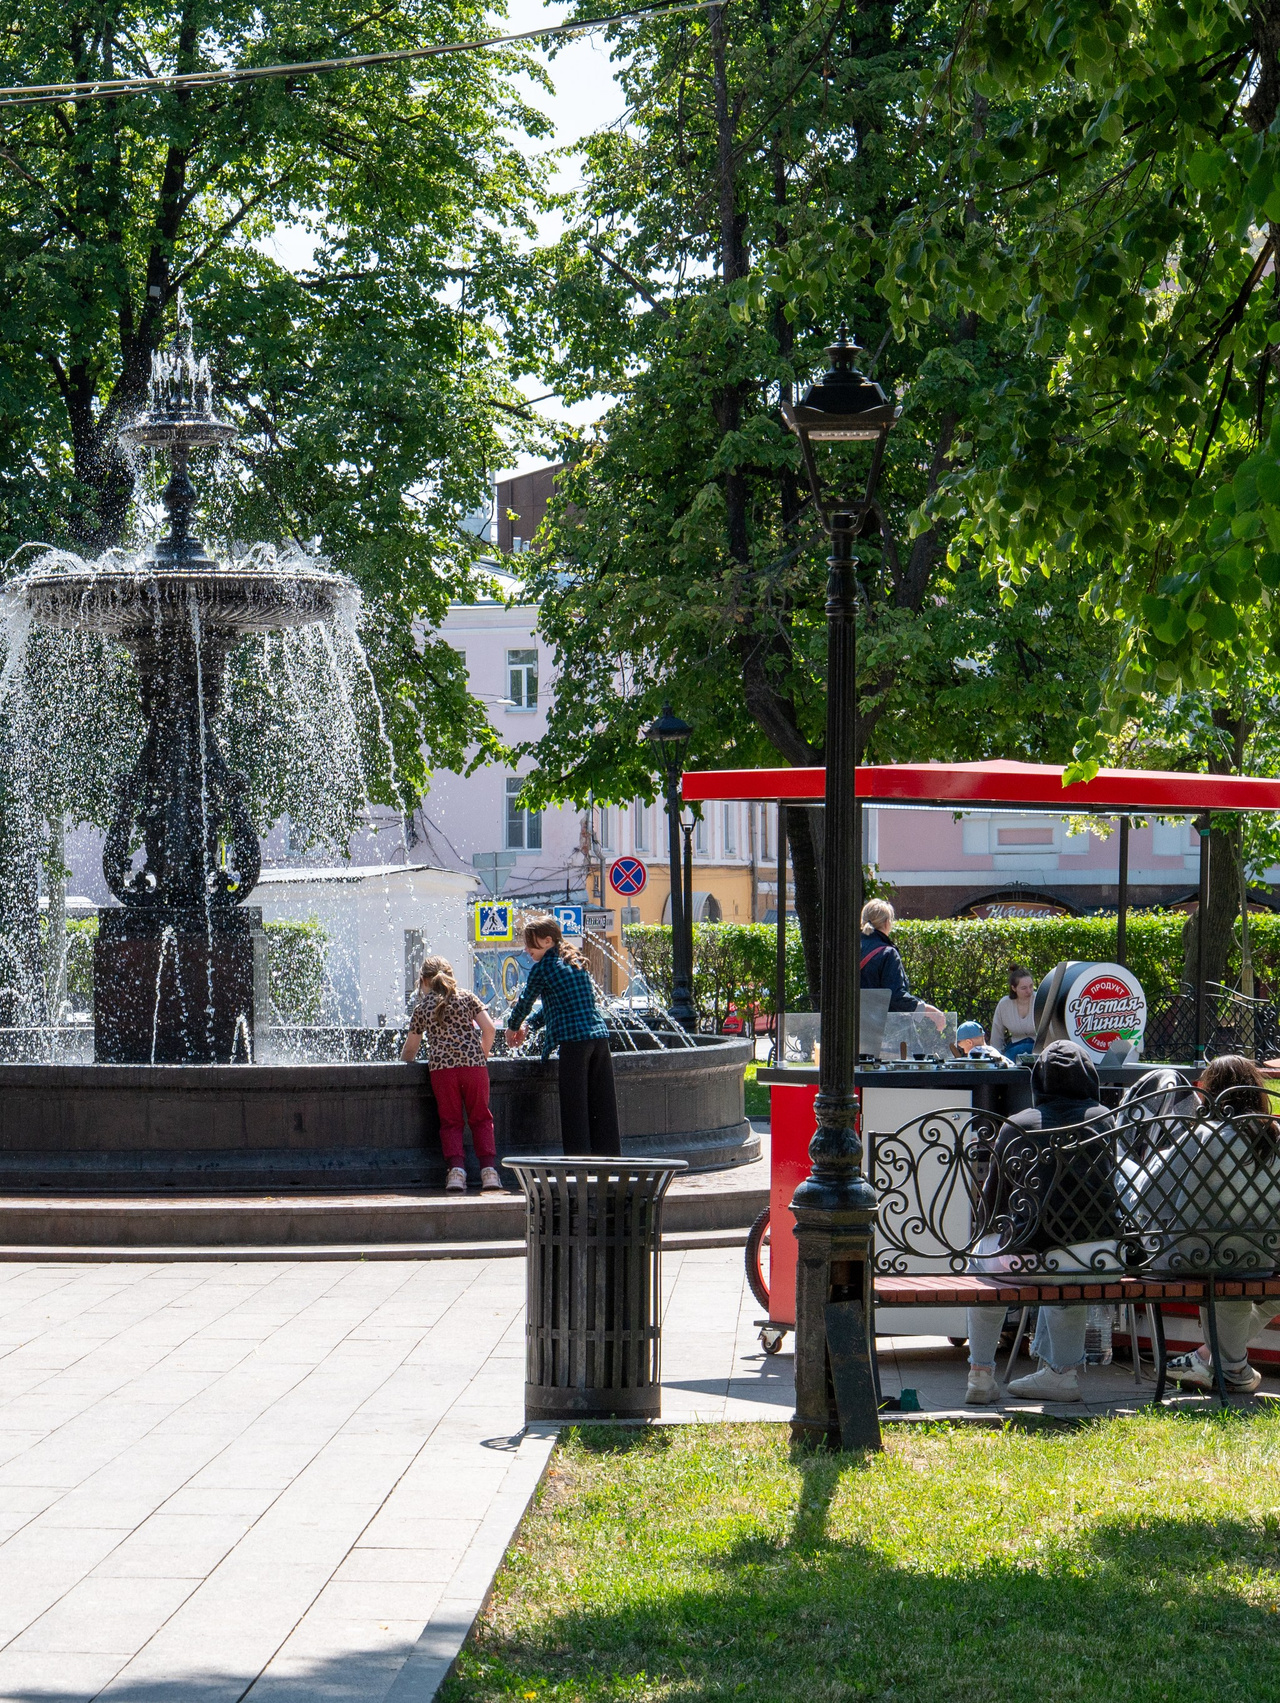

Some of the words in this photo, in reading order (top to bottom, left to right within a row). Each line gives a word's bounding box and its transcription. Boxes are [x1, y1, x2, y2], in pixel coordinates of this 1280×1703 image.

[986, 904, 1051, 918] Штолле
[559, 909, 576, 932] P
[1090, 981, 1125, 995] ПРОДУКТ
[1069, 996, 1144, 1016] Чистая
[1074, 1014, 1141, 1036] Линия
[1091, 1036, 1107, 1048] trade
